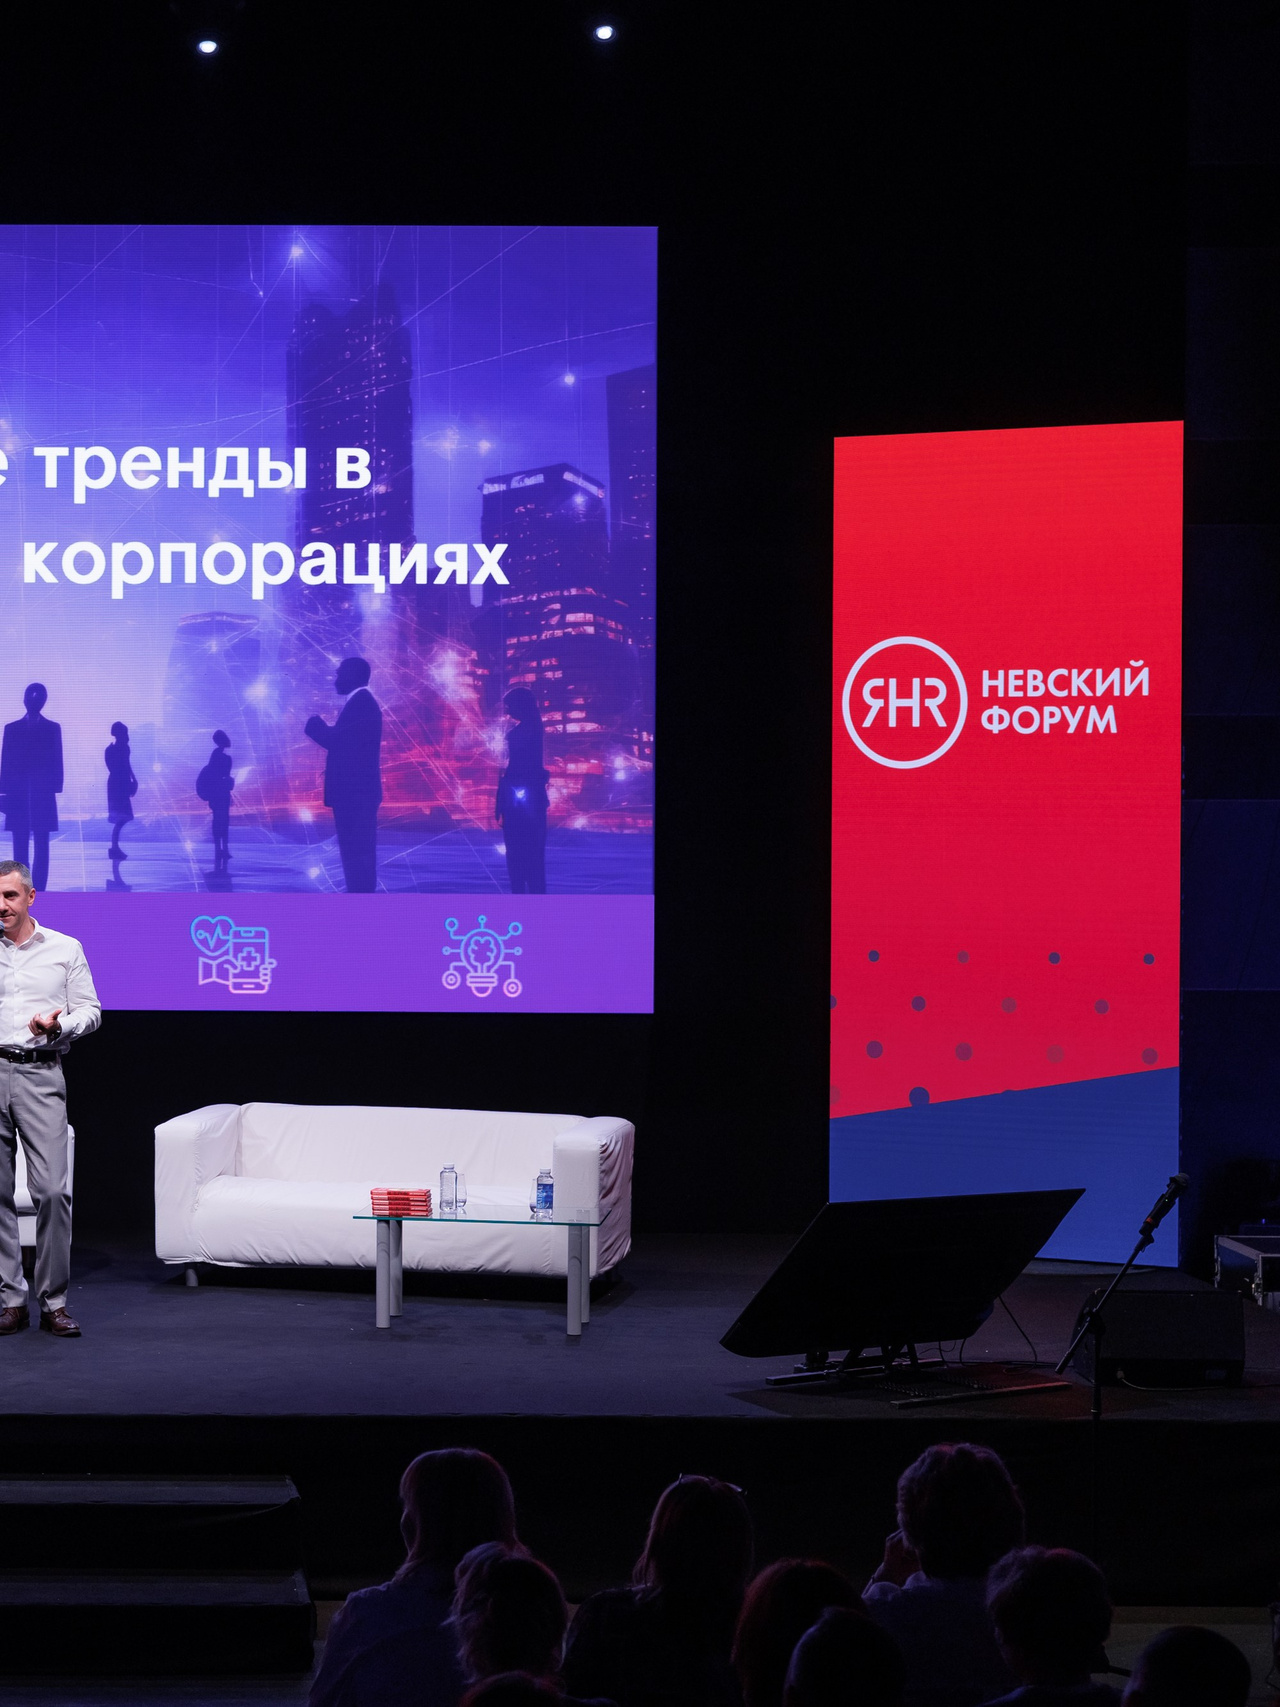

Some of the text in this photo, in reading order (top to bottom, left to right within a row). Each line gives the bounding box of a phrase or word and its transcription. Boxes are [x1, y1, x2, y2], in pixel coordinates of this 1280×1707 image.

[33, 446, 308, 504] тренды
[335, 447, 372, 489] в
[23, 541, 511, 600] корпорациях
[981, 659, 1150, 698] НЕВСКИЙ
[980, 704, 1118, 735] ФОРУМ
